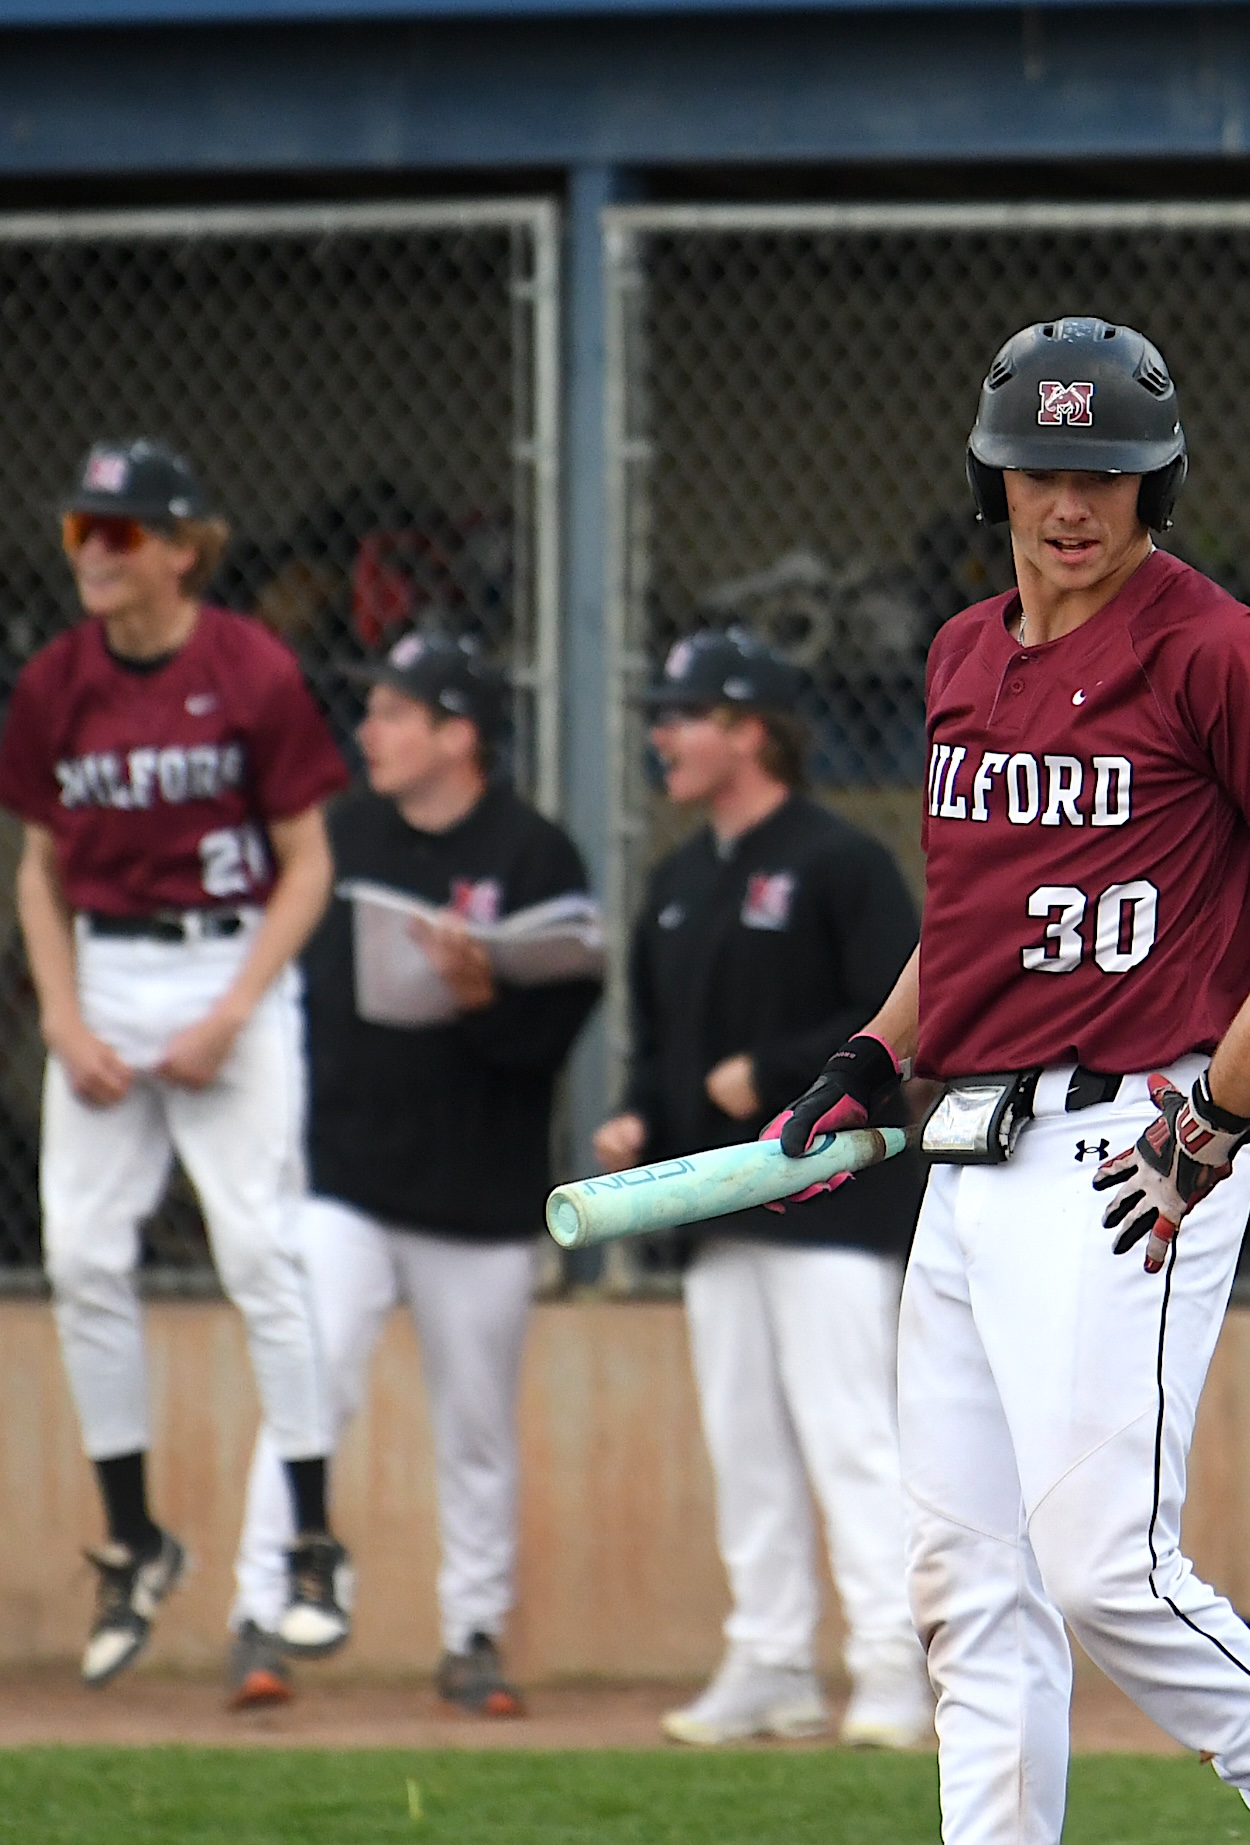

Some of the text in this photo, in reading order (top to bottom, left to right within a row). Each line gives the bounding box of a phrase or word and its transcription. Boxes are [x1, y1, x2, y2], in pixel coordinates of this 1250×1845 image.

[1038, 380, 1094, 426] M
[928, 743, 1132, 826] ILFORD
[1021, 879, 1160, 973] 30
[583, 1159, 696, 1195] ICON
